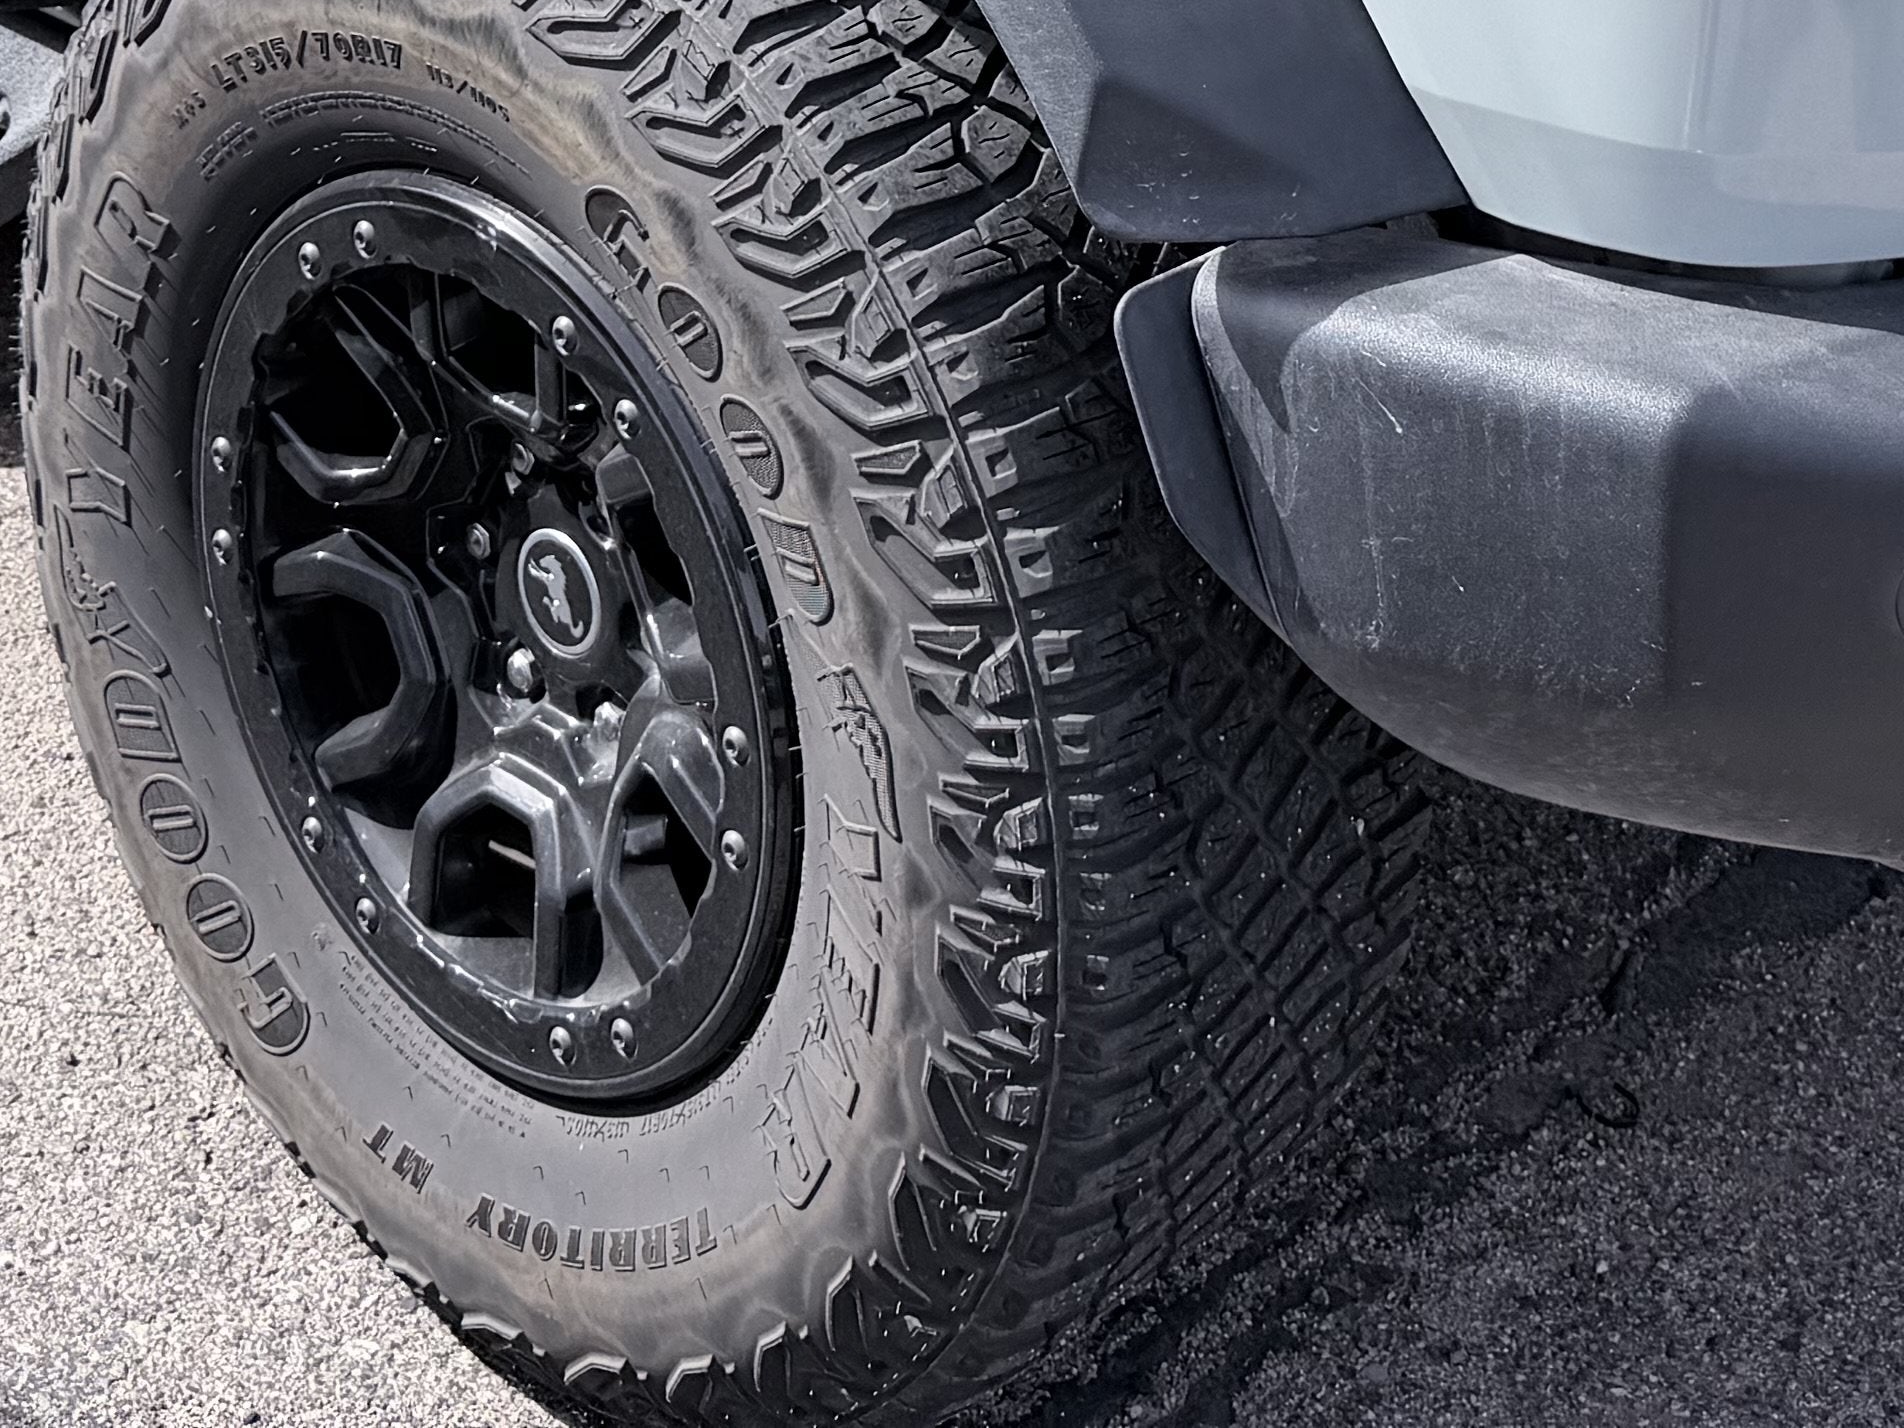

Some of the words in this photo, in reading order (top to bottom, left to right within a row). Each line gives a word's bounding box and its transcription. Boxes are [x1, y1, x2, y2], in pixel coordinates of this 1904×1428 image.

[54, 170, 315, 1058] GOODYEAR
[361, 1120, 435, 1195] MT
[465, 1192, 719, 1273] TERRITORY
